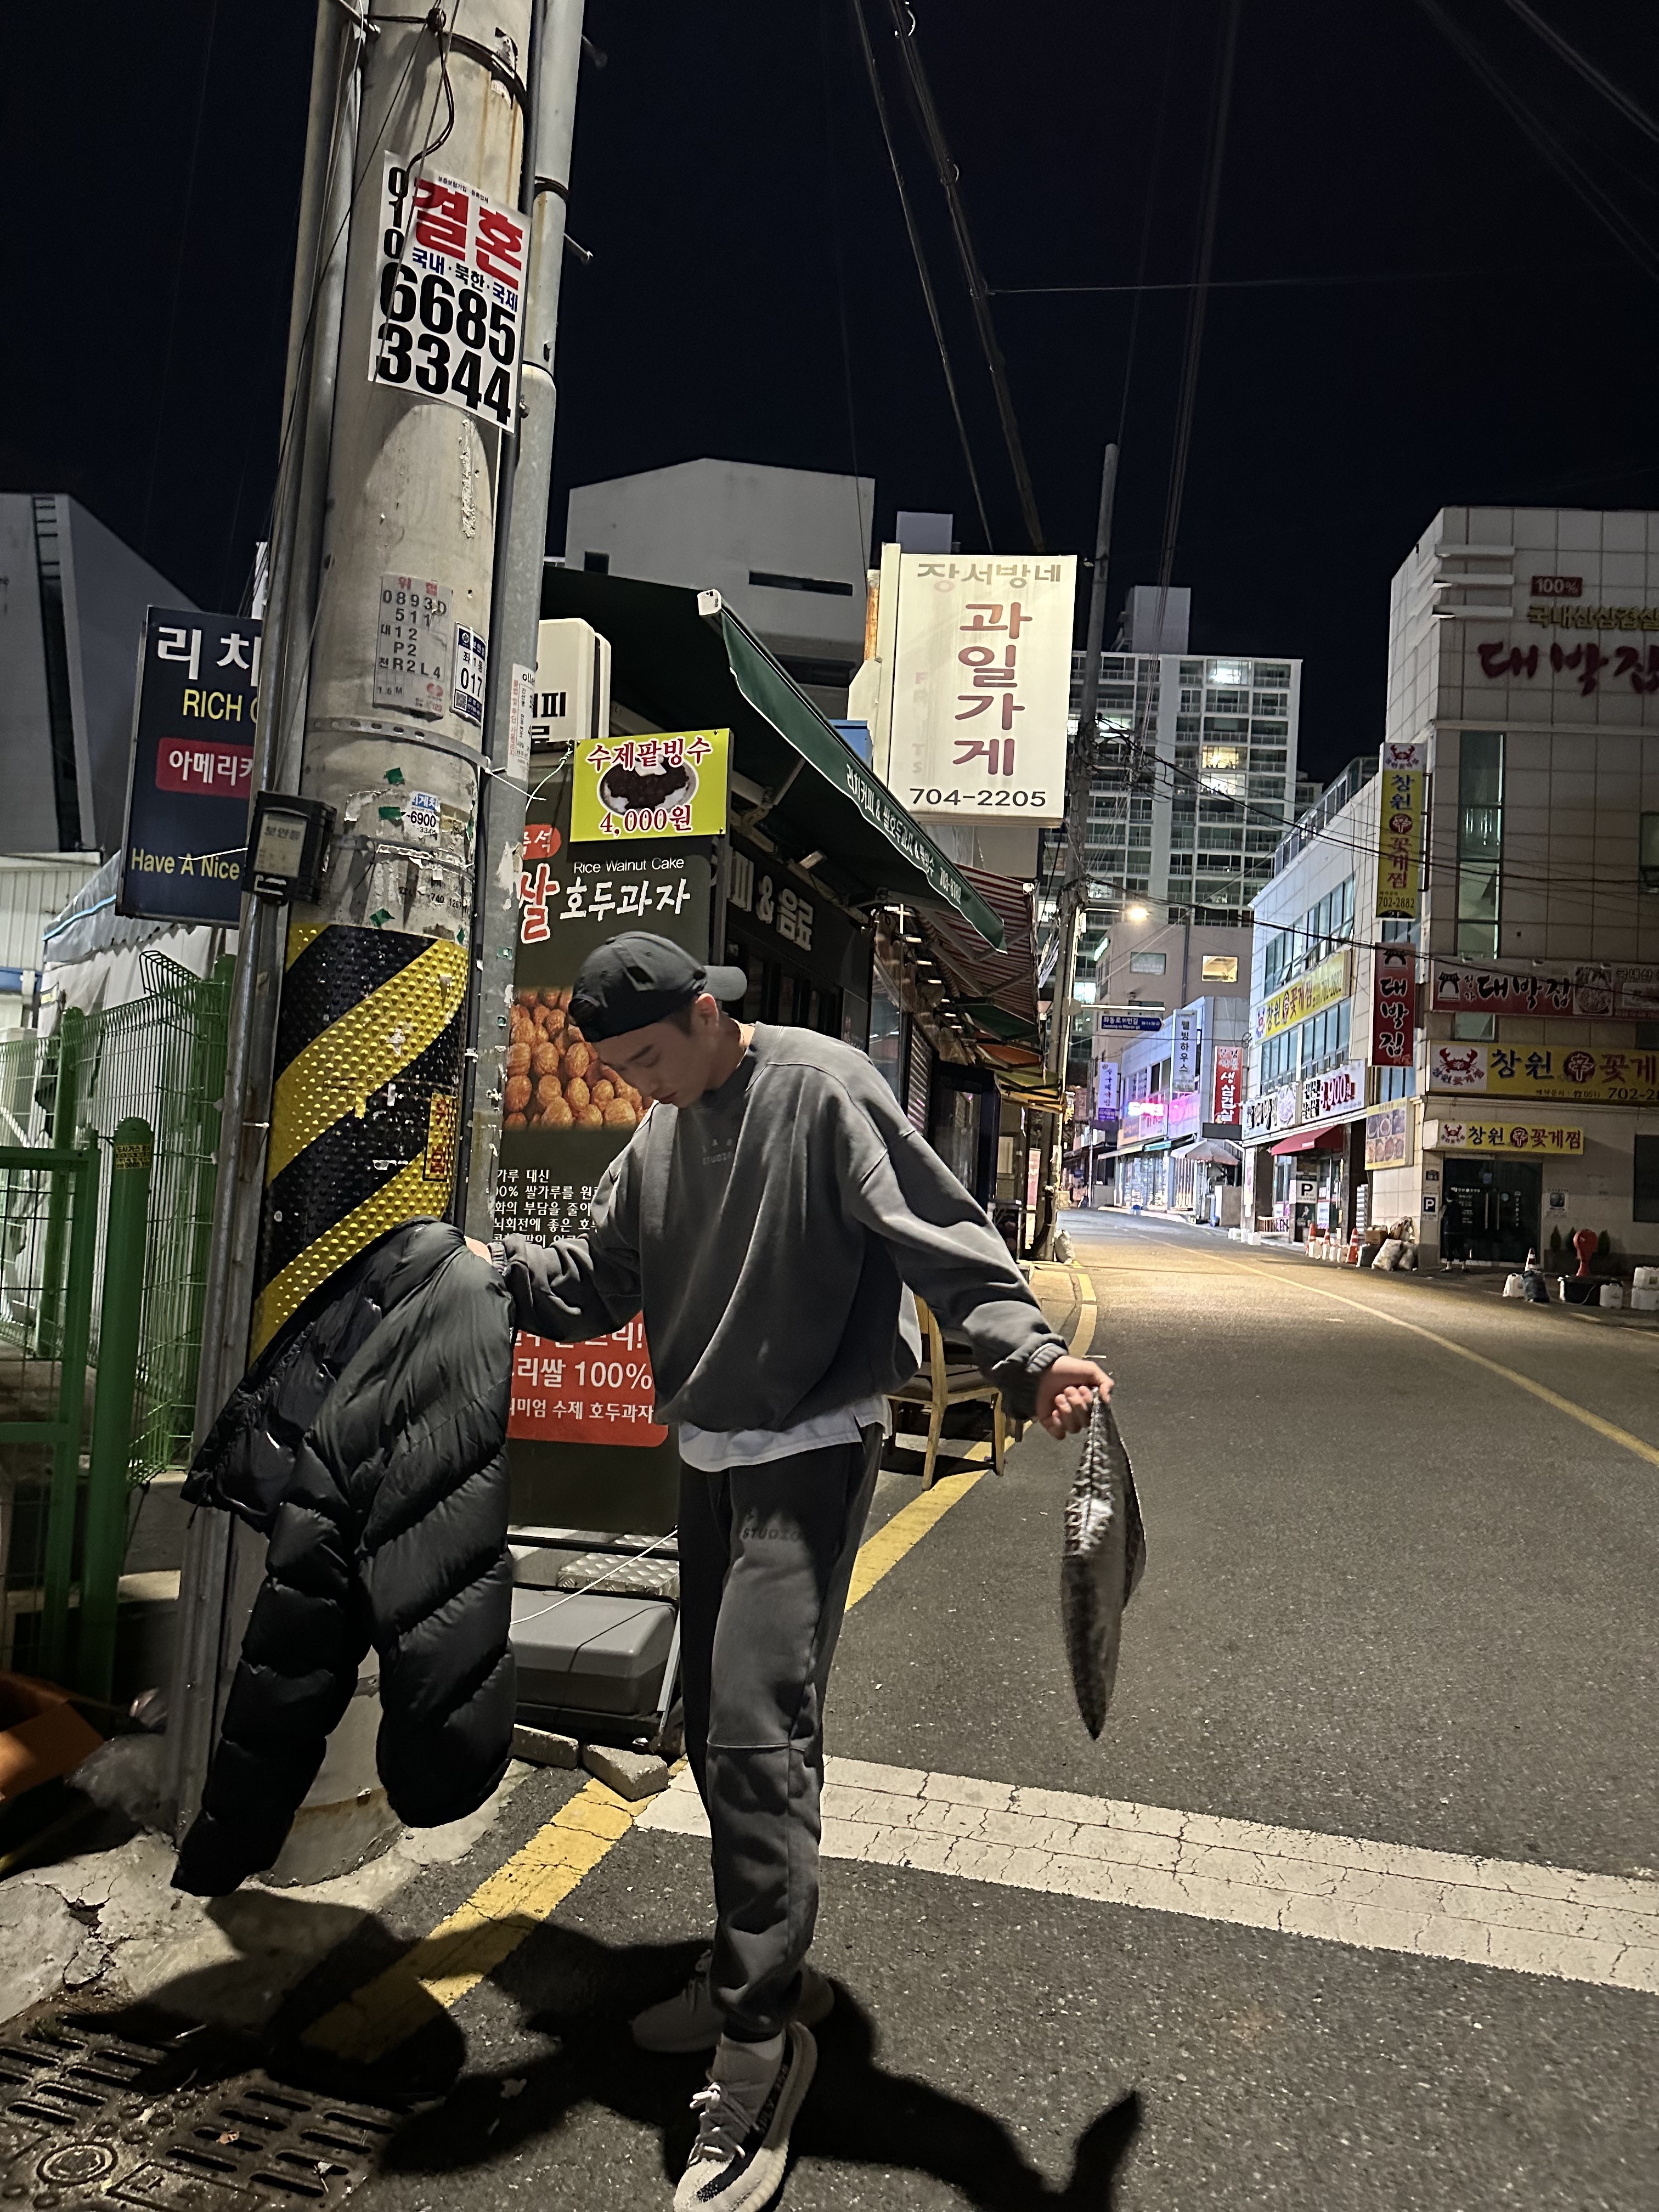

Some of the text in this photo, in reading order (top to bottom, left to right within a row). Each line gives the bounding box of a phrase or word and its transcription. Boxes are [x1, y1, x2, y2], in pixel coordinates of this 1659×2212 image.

[383, 167, 409, 259] 010
[412, 176, 523, 290] 결혼
[380, 262, 516, 366] 6685
[376, 324, 512, 426] 3344
[917, 563, 1061, 592] 장서방네
[1536, 578, 1579, 594] 100%
[460, 668, 482, 697] 017
[952, 601, 1033, 776] 과일가게
[182, 689, 244, 722] RICH
[533, 692, 566, 718] 피
[586, 737, 713, 772] 수제팥빙수
[910, 788, 1046, 806] 704-2205
[599, 804, 693, 837] 4,000원
[131, 847, 175, 873] Have
[180, 853, 194, 876] A
[201, 854, 240, 881] Nice
[573, 857, 685, 874] Rice Walnut Cake
[560, 876, 691, 922] 호두과자
[1378, 896, 1415, 909] 702-2882
[1491, 1048, 1555, 1080] 창원
[1220, 1071, 1237, 1122] 생삼겹살
[1468, 1126, 1581, 1150] 창원 꽃게찜
[526, 1169, 549, 1183] 대신
[1301, 1183, 1313, 1197] P
[525, 1185, 574, 1200] 쌀가루를
[1425, 1199, 1435, 1210] P
[523, 1201, 561, 1216] 부담을
[547, 1218, 572, 1233] 좋은
[574, 1361, 653, 1390] 100%
[552, 1401, 583, 1420] 수제
[589, 1403, 654, 1424] 호두과자
